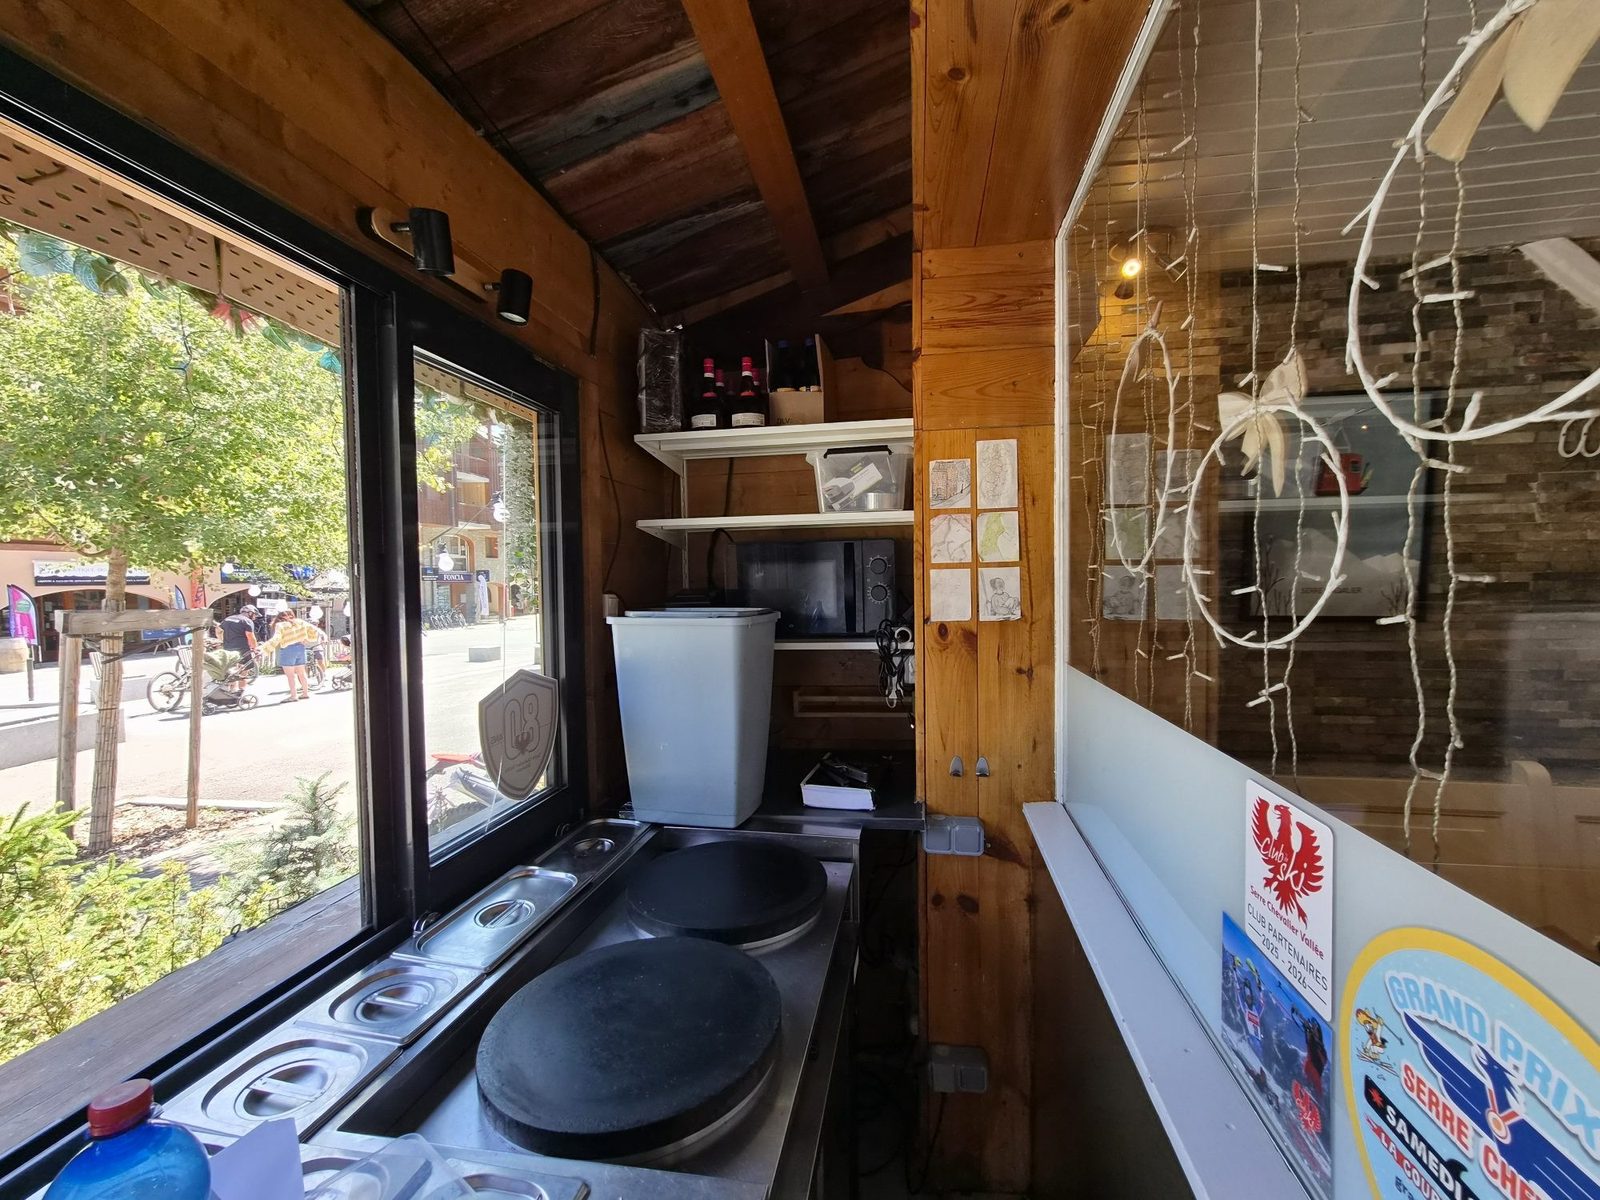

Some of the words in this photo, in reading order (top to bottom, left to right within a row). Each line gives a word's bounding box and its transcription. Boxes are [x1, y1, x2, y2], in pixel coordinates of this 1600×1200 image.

[1260, 836, 1285, 863] Club
[1247, 902, 1267, 929] CLUB
[1267, 922, 1329, 992] PARTENAIRES
[1250, 885, 1267, 907] Serre
[1266, 900, 1299, 935] Chevalier
[1300, 928, 1325, 961] Vallée
[1261, 935, 1280, 961] 2025
[1287, 959, 1308, 990] 2026
[1388, 975, 1488, 1044] GRAND
[1402, 1063, 1470, 1152] SERRE
[1381, 1132, 1398, 1160] LA
[1385, 1105, 1462, 1200] SAMEDI
